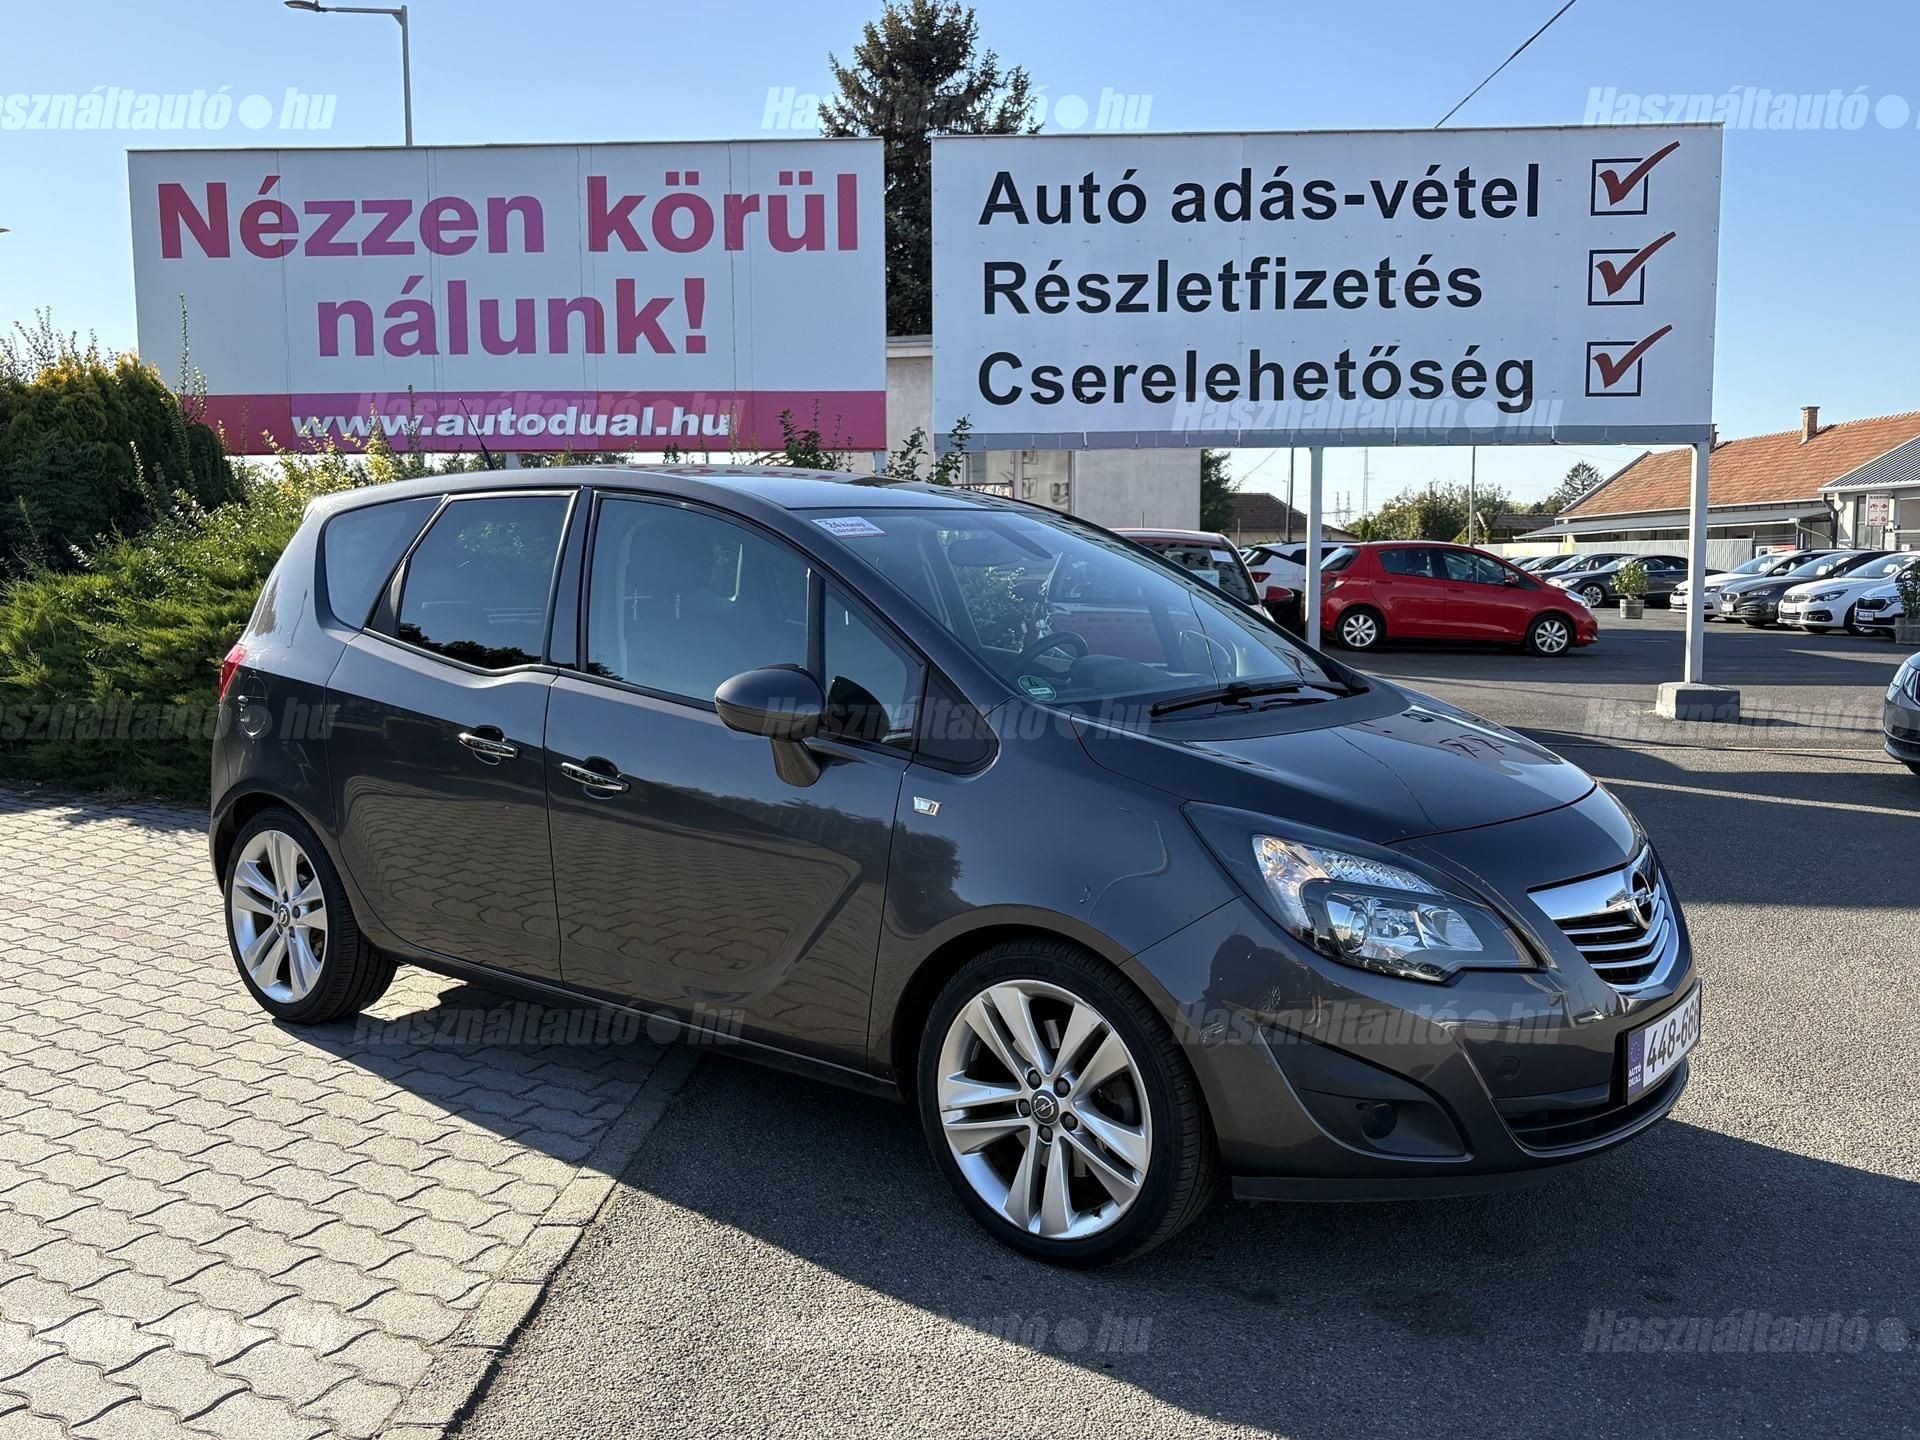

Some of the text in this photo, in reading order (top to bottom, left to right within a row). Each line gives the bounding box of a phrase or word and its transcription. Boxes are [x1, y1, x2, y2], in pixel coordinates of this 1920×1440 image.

[158, 171, 859, 260] Nézzen körül
[978, 162, 1541, 226] Autó adás-vétel
[318, 276, 708, 357] nálunk!
[983, 253, 1483, 316] Részletfizetés
[978, 343, 1536, 413] Cserelehetőség
[292, 405, 732, 437] www.autodual.hu
